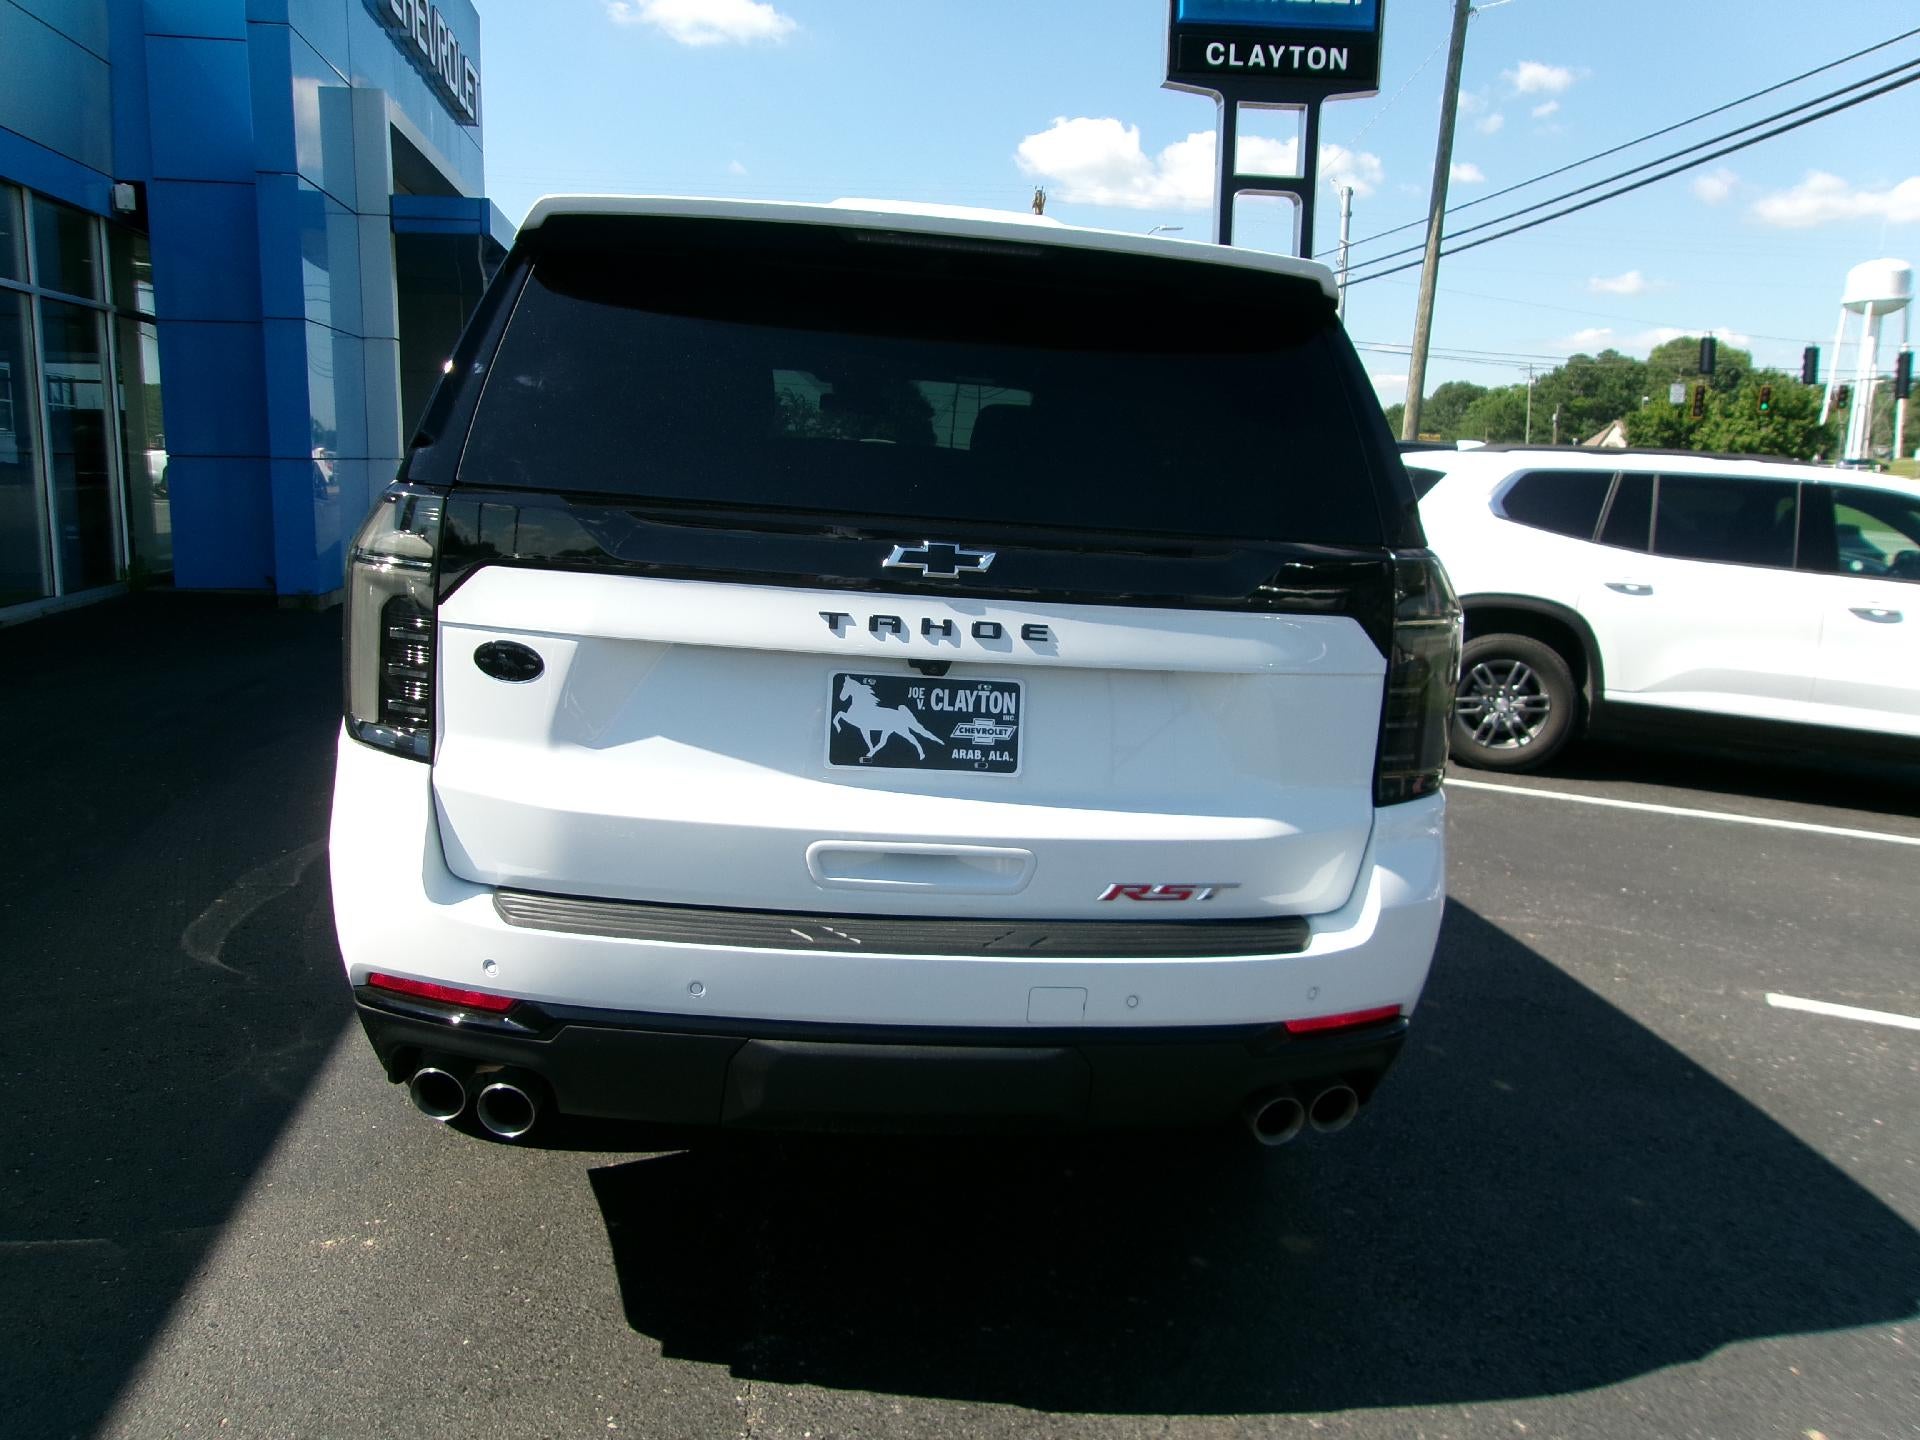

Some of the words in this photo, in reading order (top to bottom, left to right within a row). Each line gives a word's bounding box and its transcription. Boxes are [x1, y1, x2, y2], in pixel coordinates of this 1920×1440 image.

[1206, 42, 1348, 71] CLAYTON
[819, 611, 1048, 642] TAHOE
[907, 687, 926, 698] JOE
[917, 699, 926, 710] V.
[930, 688, 1016, 714] CLAYTON
[958, 727, 1008, 736] CHEVROLET
[951, 749, 985, 761] ARAB,
[988, 751, 1014, 761] ALA.
[1096, 882, 1242, 901] RST
